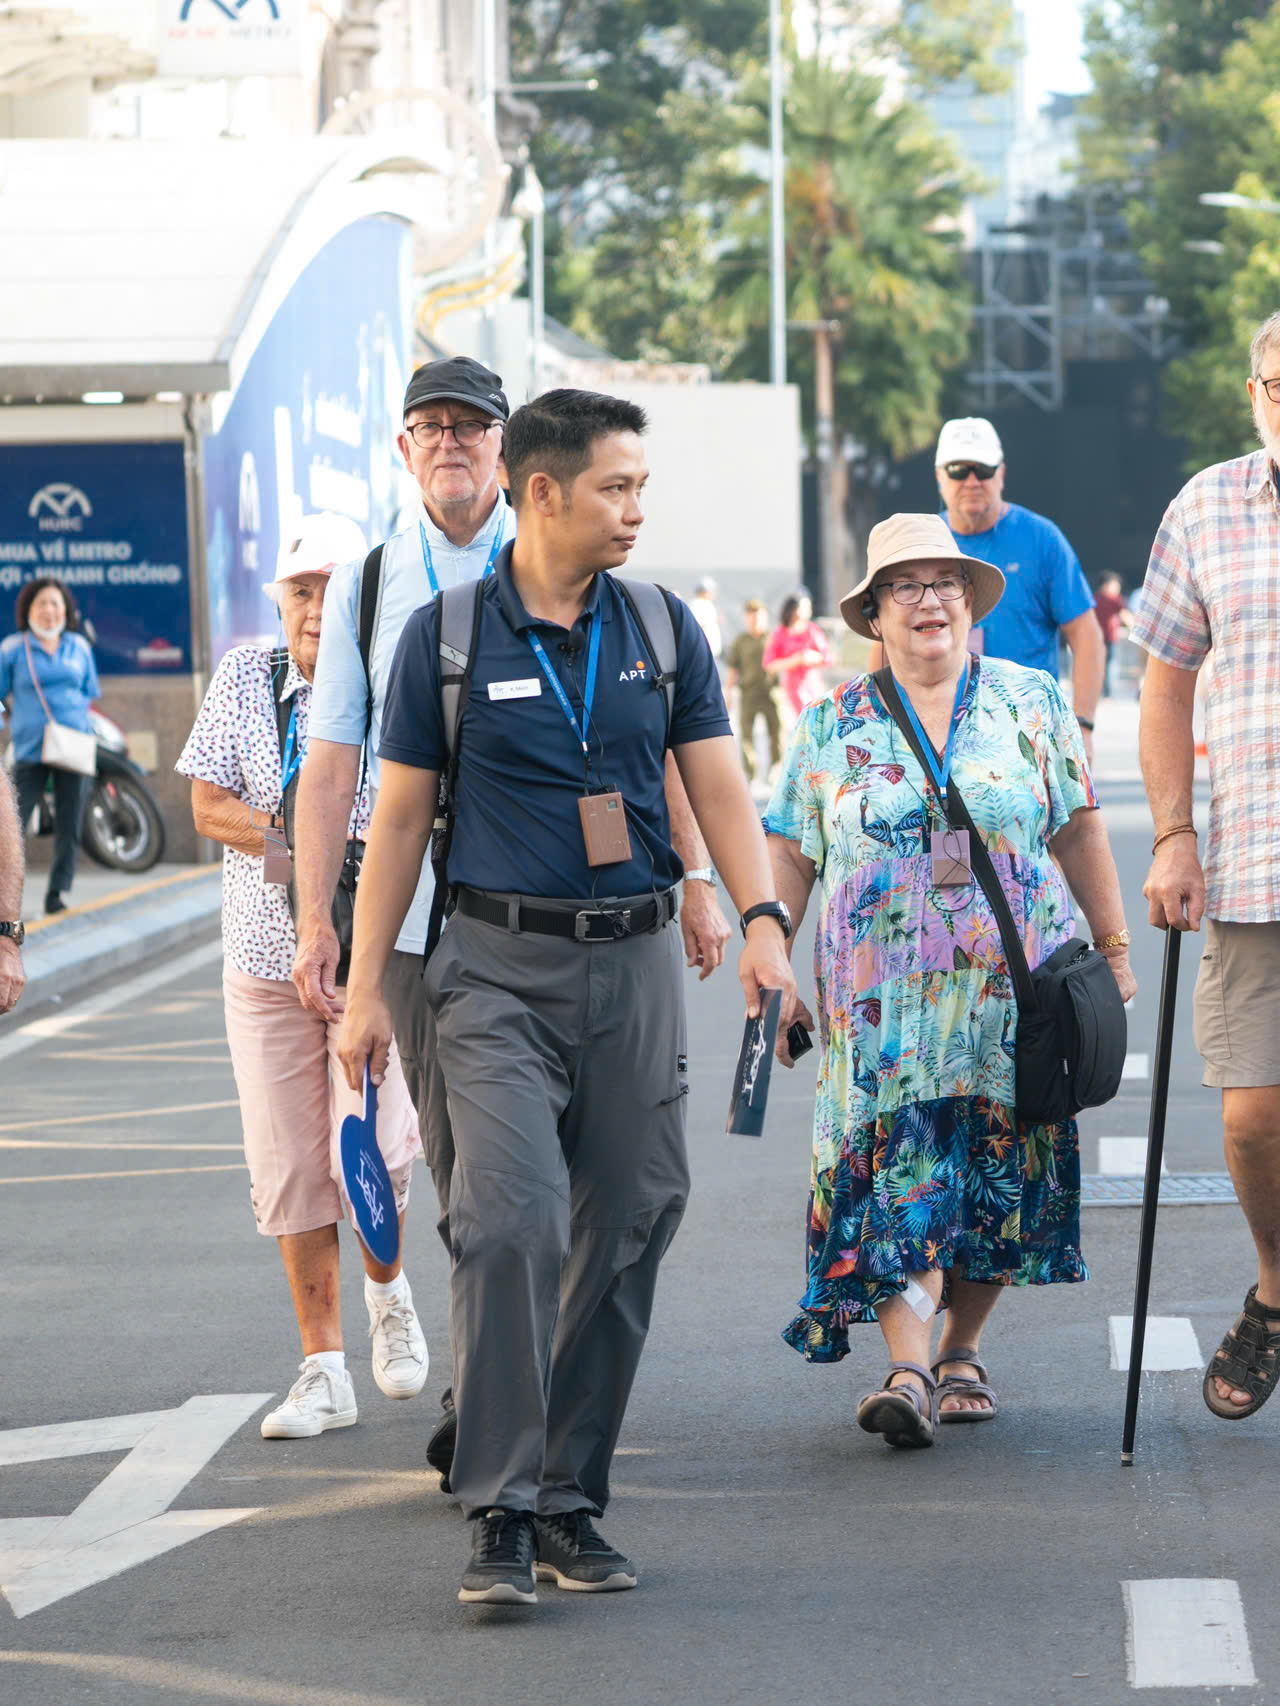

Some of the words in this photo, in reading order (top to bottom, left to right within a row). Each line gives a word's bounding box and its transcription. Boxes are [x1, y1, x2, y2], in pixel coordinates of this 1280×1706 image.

[69, 541, 132, 561] METRO
[107, 561, 181, 585] CHÓNG
[619, 669, 646, 681] APT
